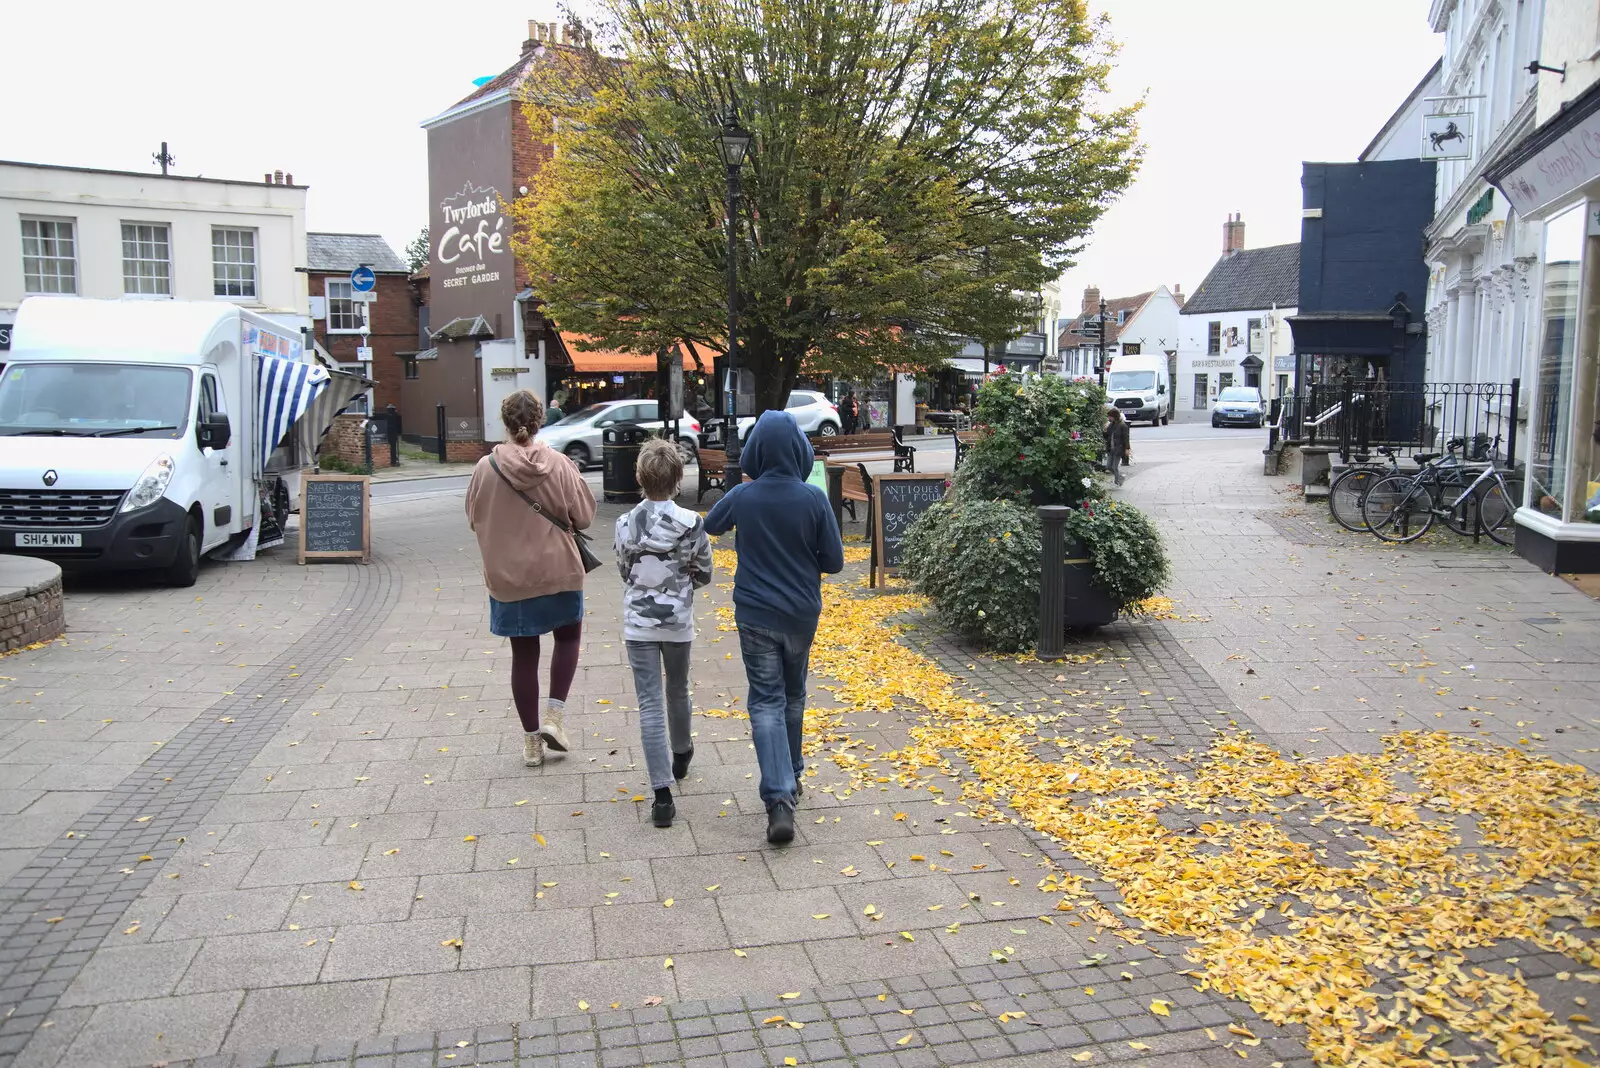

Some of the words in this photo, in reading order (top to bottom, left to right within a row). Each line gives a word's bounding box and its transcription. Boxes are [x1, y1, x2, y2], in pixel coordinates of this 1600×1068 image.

[442, 196, 496, 224] Twyfords
[438, 216, 503, 263] Café
[443, 276, 468, 288] SECRET
[471, 271, 500, 284] GARDEN
[1192, 360, 1201, 368] BAR
[883, 485, 939, 495] ANTIQUES
[891, 494, 907, 503] AT
[23, 534, 49, 545] SH14
[51, 534, 75, 545] WWN
